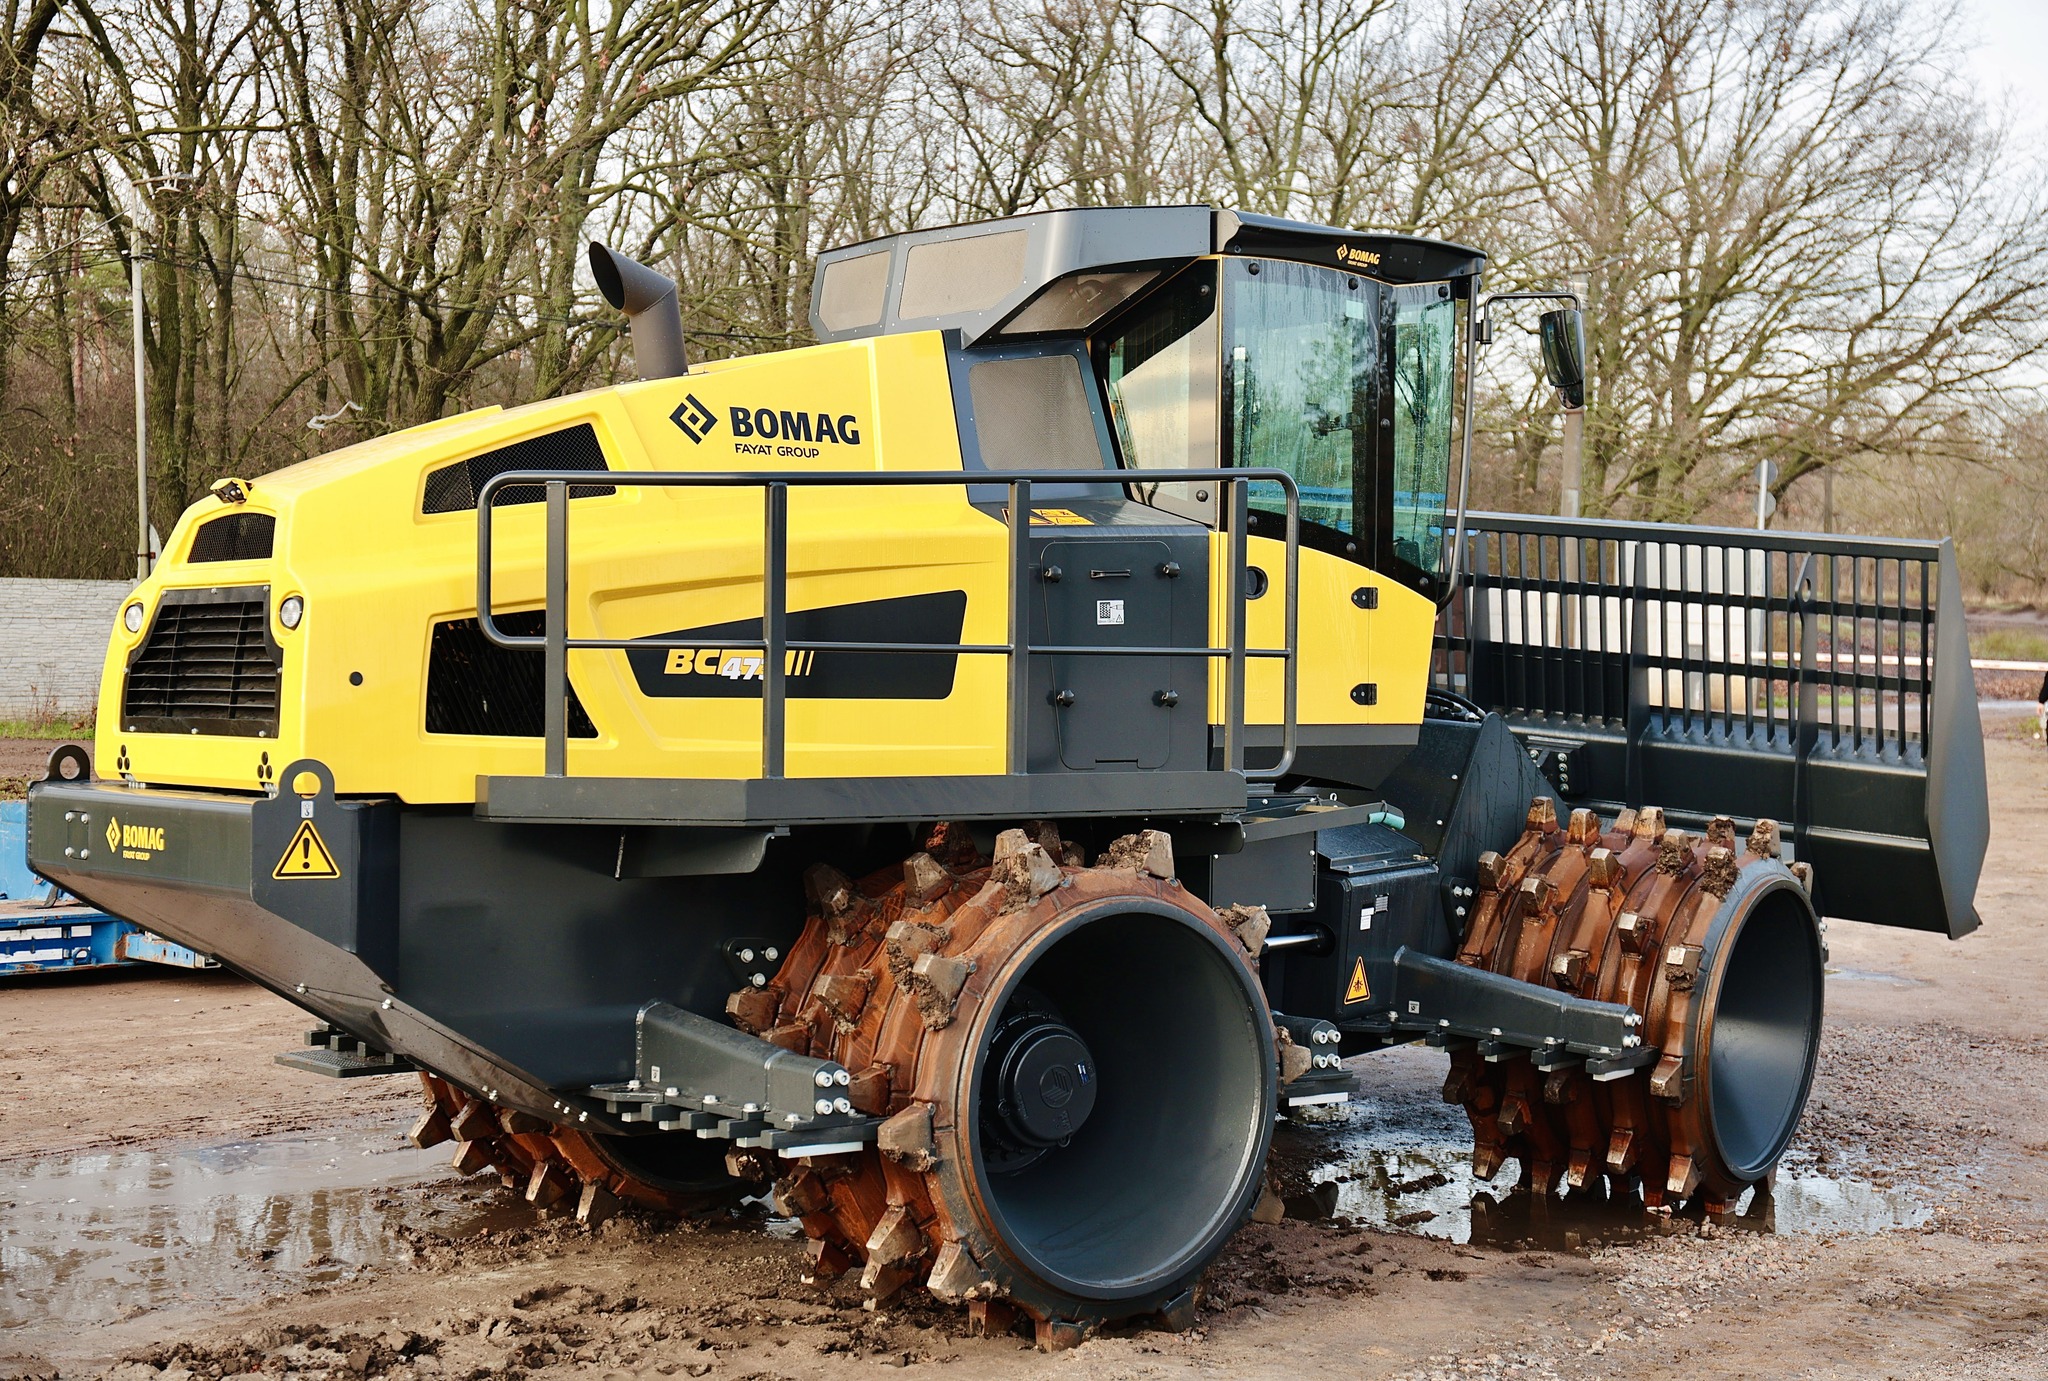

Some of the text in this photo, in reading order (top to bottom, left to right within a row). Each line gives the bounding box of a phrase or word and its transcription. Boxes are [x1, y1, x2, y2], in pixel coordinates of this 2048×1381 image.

[1348, 248, 1381, 265] BOMAG
[729, 406, 861, 445] BOMAG
[735, 443, 820, 459] FAYAT GROUP
[122, 824, 165, 851] BOMAG
